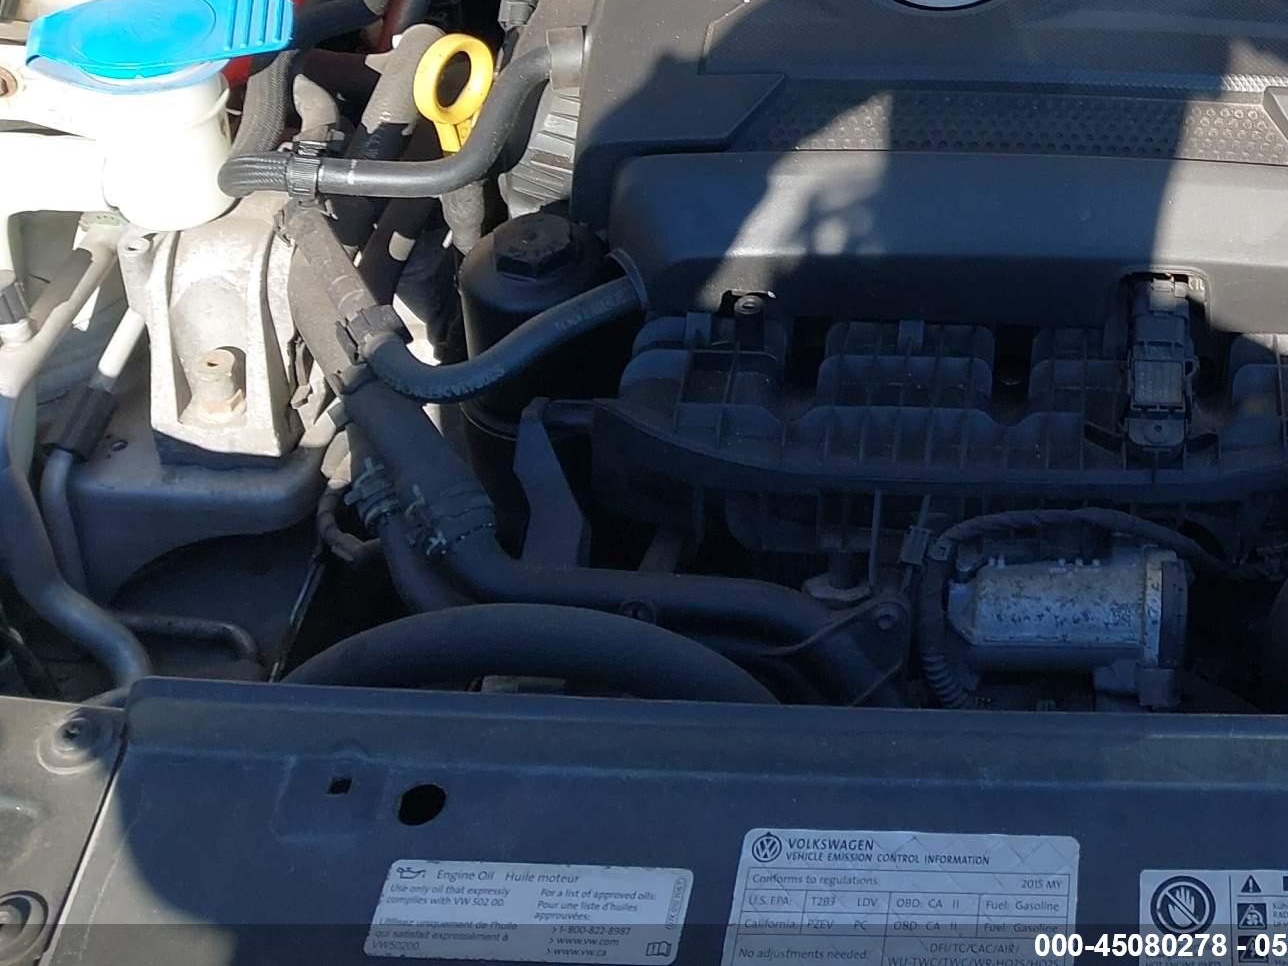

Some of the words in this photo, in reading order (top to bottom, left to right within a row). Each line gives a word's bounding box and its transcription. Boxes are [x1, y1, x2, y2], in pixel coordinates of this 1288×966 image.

[787, 837, 874, 851] VOLKSWAGEN
[785, 851, 823, 862] VEHICLE
[827, 852, 872, 863] EMISSION
[877, 853, 920, 865] CONTROL
[924, 854, 990, 866] INFORMATION
[436, 869, 476, 883] Engine
[478, 871, 495, 881] Oil
[504, 872, 535, 883] Huile
[537, 873, 580, 883] moteur
[751, 873, 803, 884] Conforms
[805, 874, 817, 884] to
[1021, 879, 1044, 890] 2015
[1045, 880, 1063, 890] MY
[390, 884, 408, 893] Use
[409, 885, 429, 895] only
[431, 884, 444, 893] oil
[446, 884, 465, 894] that
[467, 887, 512, 898] expressly
[540, 888, 555, 897] For
[565, 889, 579, 898] list
[581, 889, 593, 899] of
[593, 890, 637, 901] approved
[386, 896, 428, 906] complies
[430, 896, 451, 905] with
[454, 897, 471, 906] VW
[537, 900, 559, 910] Pour
[560, 902, 578, 910] une
[580, 900, 600, 910] liste
[601, 901, 639, 912] d'huiles
[810, 897, 836, 908] T2B3
[857, 897, 879, 907] LDV
[928, 898, 944, 909] CA
[1015, 900, 1060, 912] Gasoline
[560, 925, 632, 936] 1-800-822-8987
[925, 921, 941, 932] CA
[1013, 922, 1059, 934] Gasoline
[556, 938, 620, 946] www.vw.com
[553, 947, 607, 956] www.vw.ca
[739, 947, 755, 959] No
[756, 947, 824, 962] adjustments
